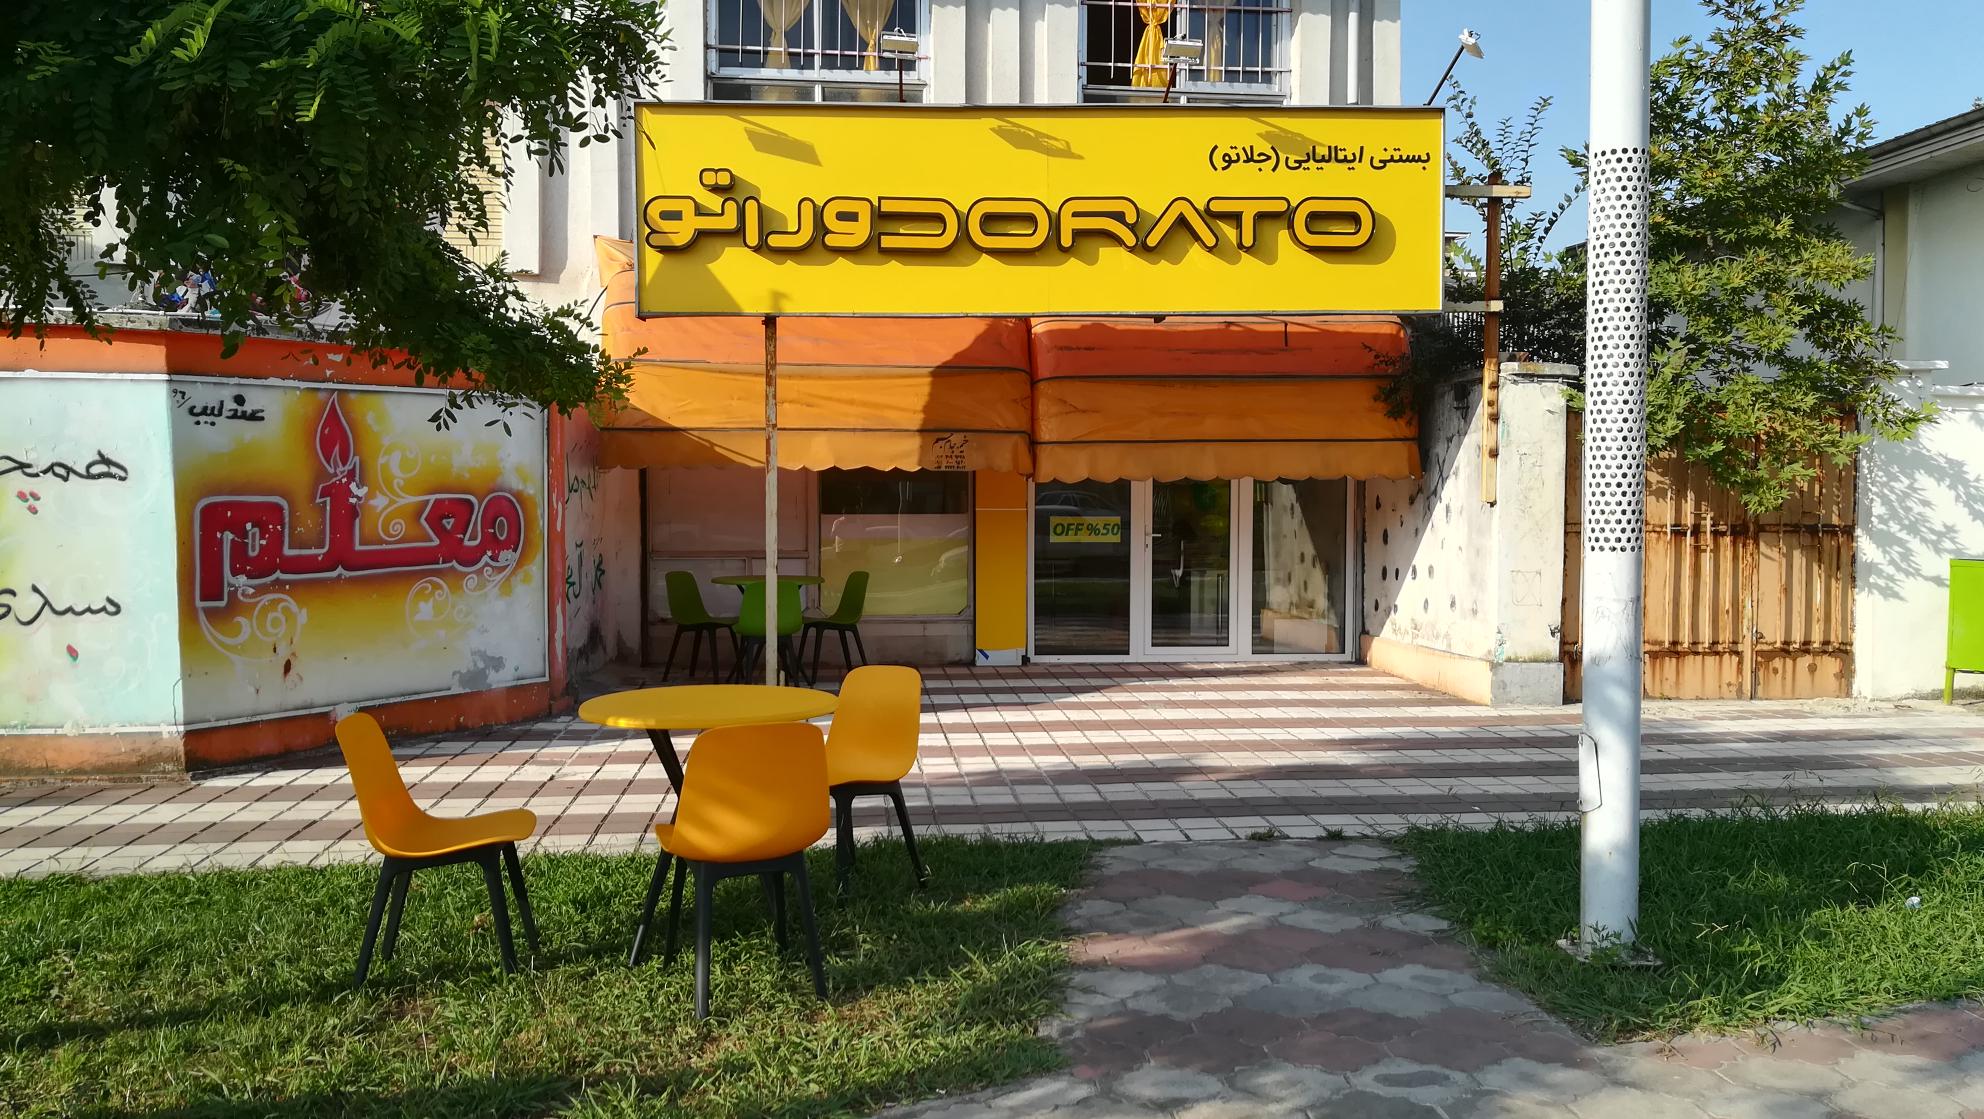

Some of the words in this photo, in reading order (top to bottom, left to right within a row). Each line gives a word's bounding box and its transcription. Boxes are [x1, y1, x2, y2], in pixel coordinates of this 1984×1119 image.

[1208, 144, 1280, 172] (جلاتو)
[1284, 145, 1364, 171] ایتالیایی
[1369, 147, 1431, 171] بستنی
[878, 196, 1376, 254] DORATO
[188, 394, 265, 427] عندلیب
[194, 455, 525, 608] معلم
[1052, 523, 1084, 536] OFF
[1086, 523, 1120, 536] %50
